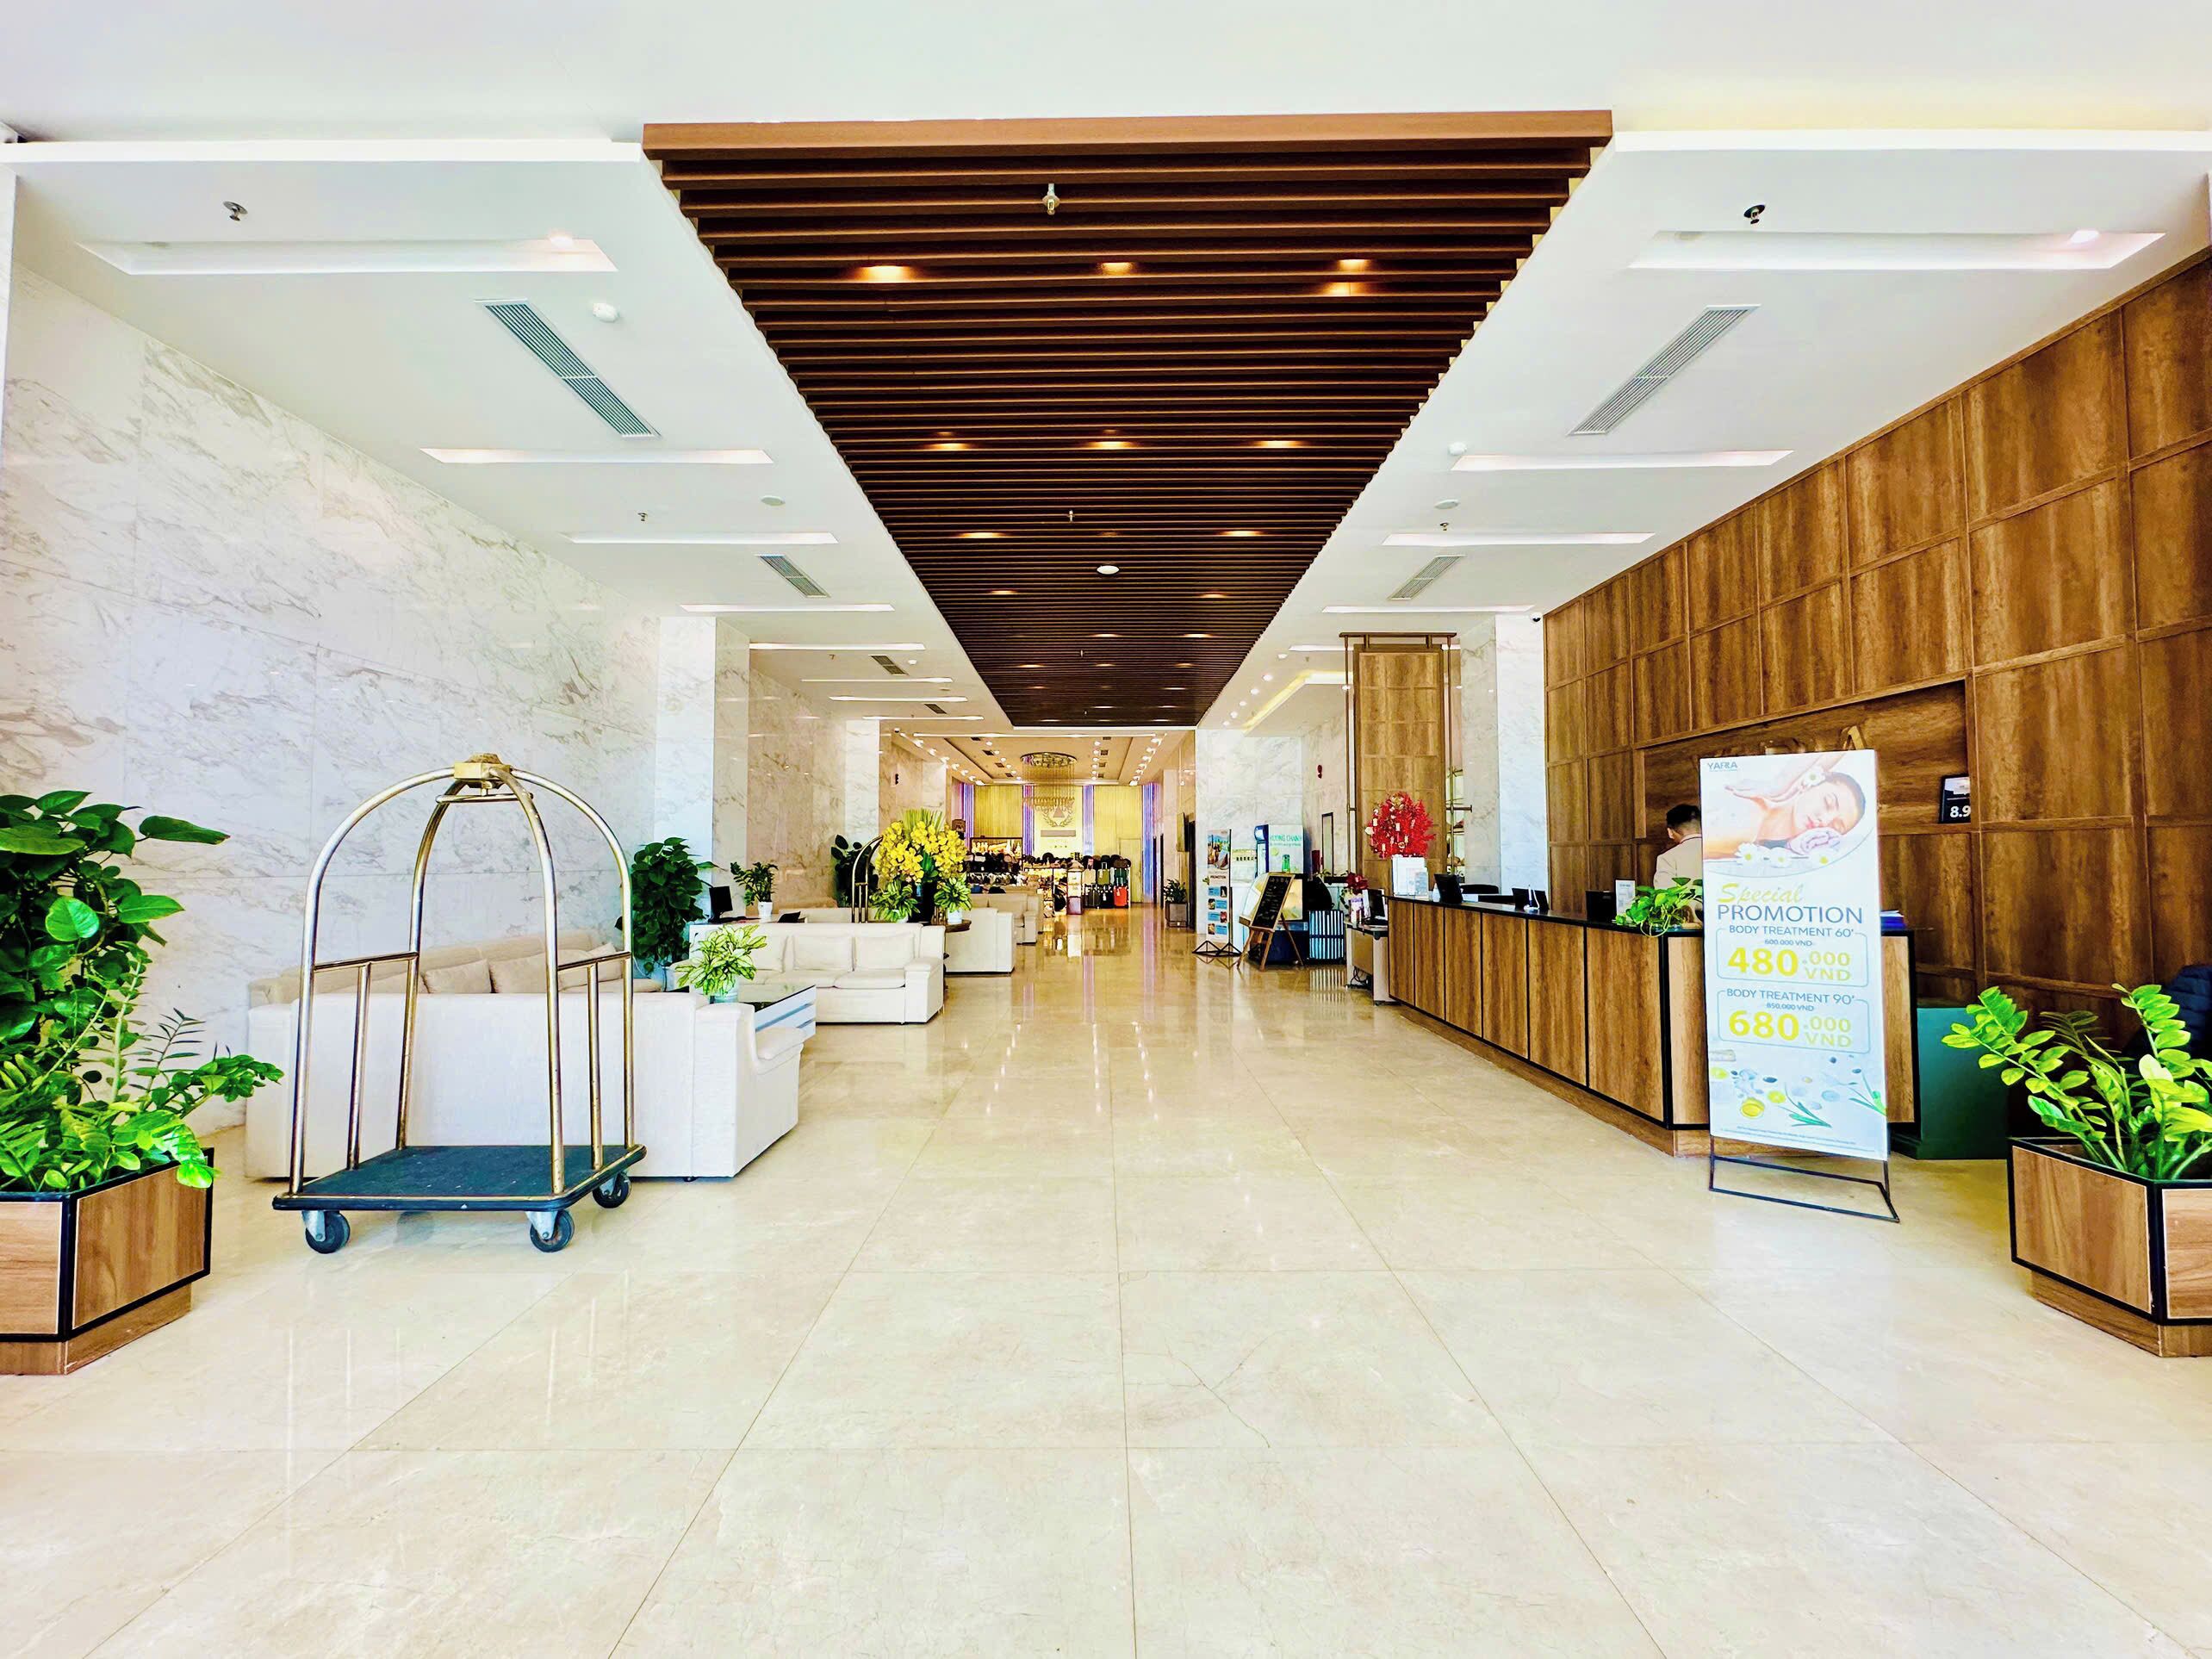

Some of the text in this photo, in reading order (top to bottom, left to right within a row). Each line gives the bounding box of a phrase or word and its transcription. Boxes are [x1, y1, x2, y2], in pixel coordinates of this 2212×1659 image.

[1717, 883, 1804, 904] Special
[1718, 904, 1863, 924] PROMOTION
[1729, 924, 1854, 938] BODY TREATMENT 60'
[1805, 967, 1851, 981] VND
[1726, 988, 1855, 1005] BODY TREATMENT 90'
[1805, 1033, 1852, 1047] VND
